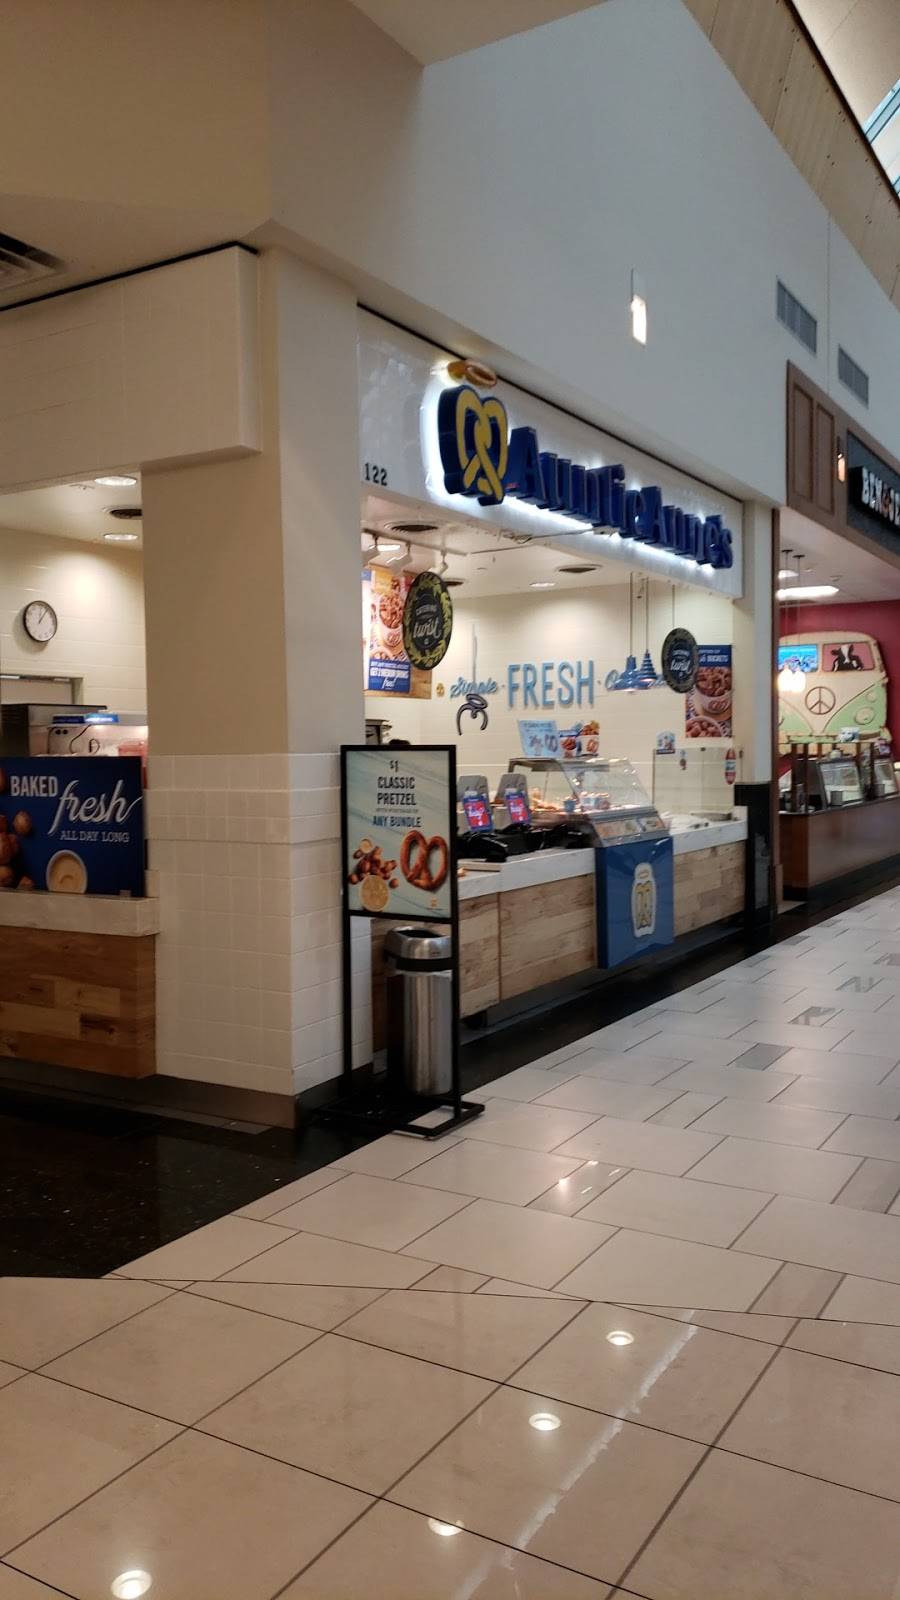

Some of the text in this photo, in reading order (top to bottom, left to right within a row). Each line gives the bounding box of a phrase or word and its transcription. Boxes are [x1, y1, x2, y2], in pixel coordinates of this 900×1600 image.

[364, 462, 388, 487] 122
[499, 426, 643, 539] Auntie
[507, 660, 595, 707] FRESH
[377, 776, 416, 789] CLASSIC
[10, 775, 143, 835] BAKED fresh
[377, 792, 416, 805] PRETZEL
[373, 815, 422, 827] ANY BUNDLE
[60, 830, 130, 842] ALL DAY LONG
